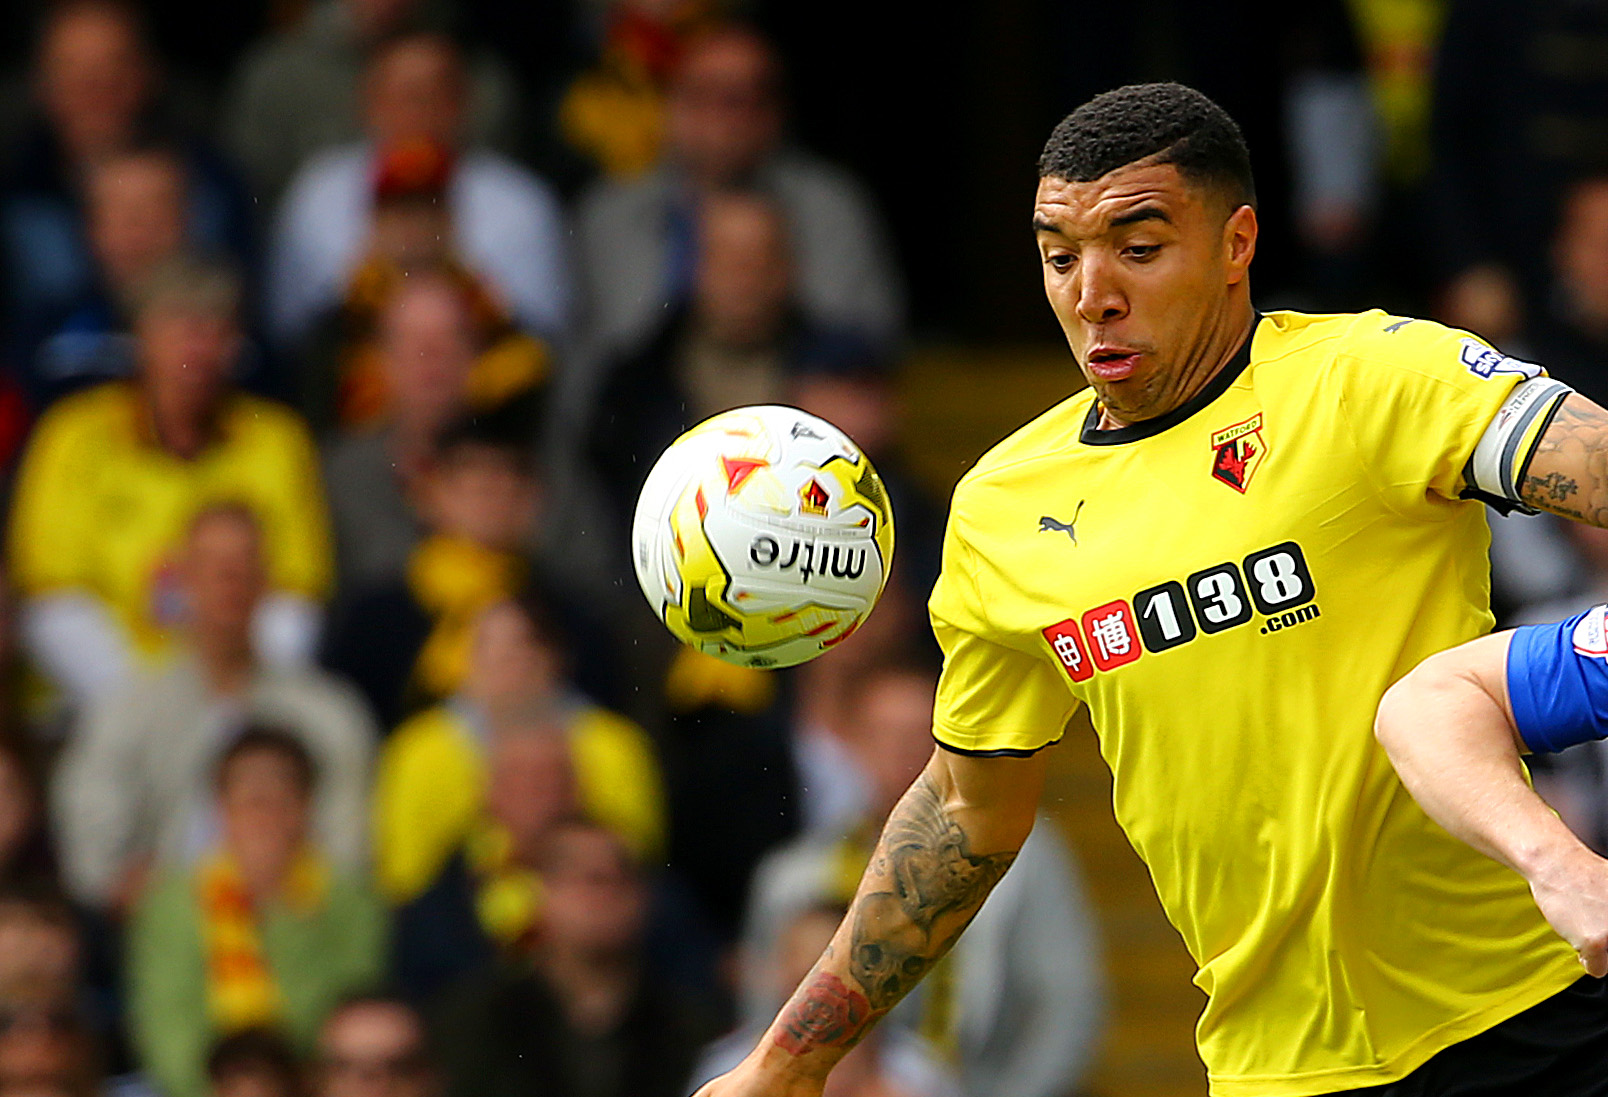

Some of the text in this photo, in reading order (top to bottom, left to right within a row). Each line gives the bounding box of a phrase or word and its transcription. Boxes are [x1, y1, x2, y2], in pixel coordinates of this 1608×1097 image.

[1217, 420, 1257, 442] WATFORD
[751, 536, 867, 585] mitre
[1260, 603, 1321, 635] .com
